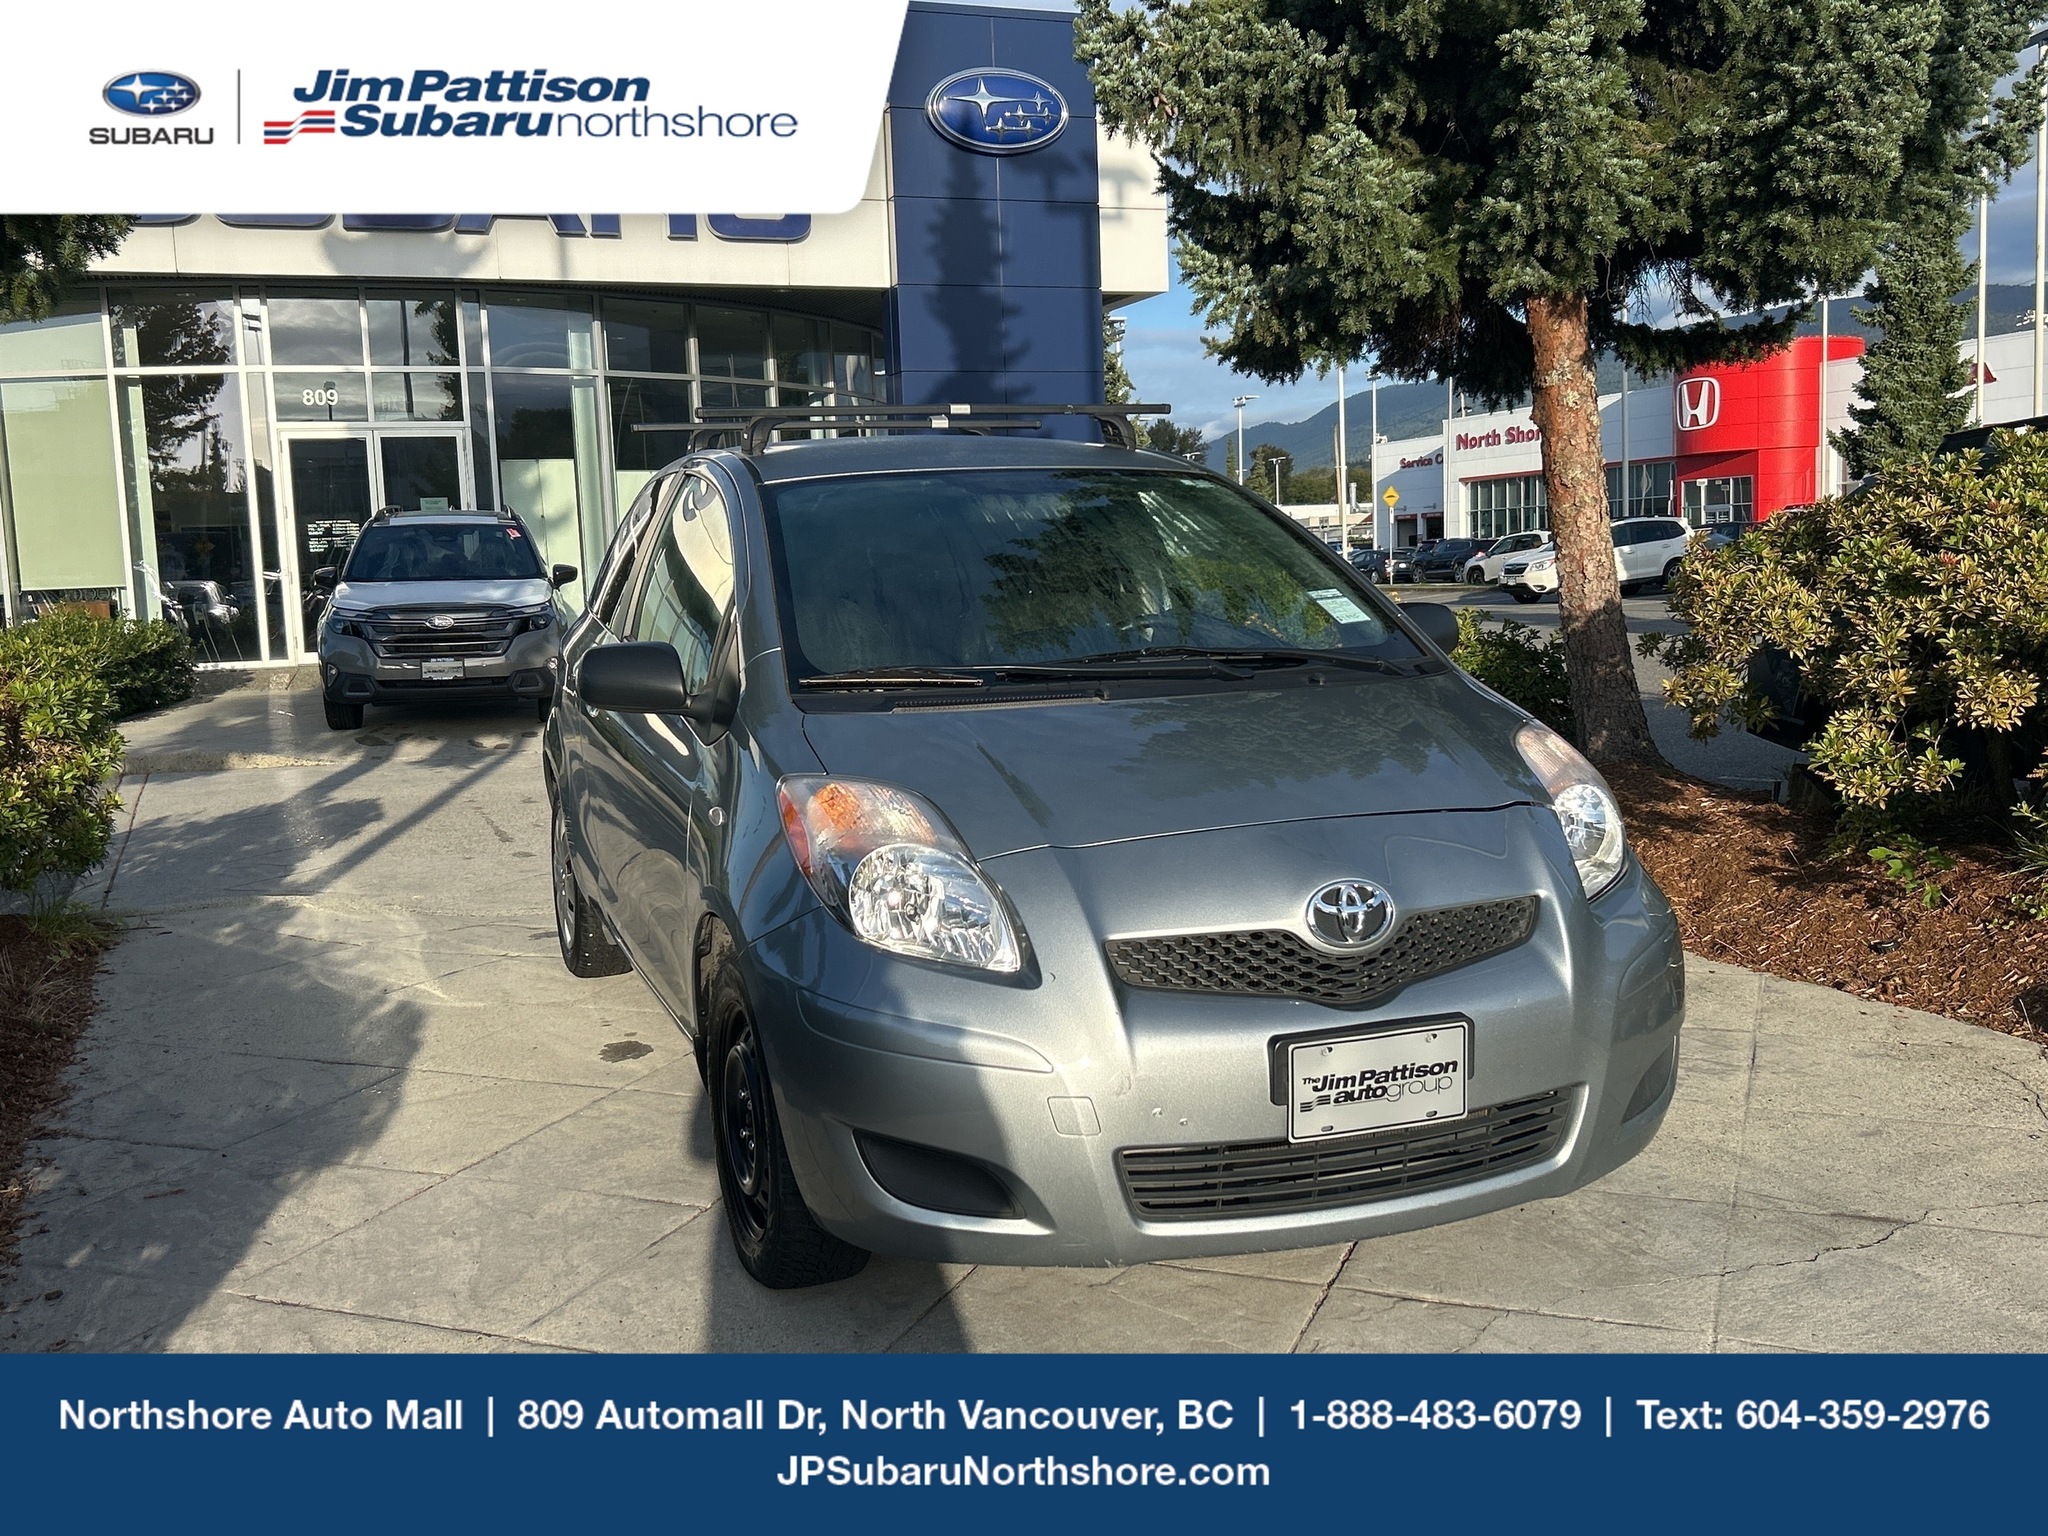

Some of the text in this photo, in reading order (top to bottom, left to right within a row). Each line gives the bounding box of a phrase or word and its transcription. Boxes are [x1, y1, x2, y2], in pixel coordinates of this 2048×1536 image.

[302, 389, 339, 406] 809
[1456, 425, 1542, 451] North Shor
[1399, 456, 1433, 469] Service
[1301, 1076, 1320, 1085] The
[1357, 1060, 1459, 1087] Pattison
